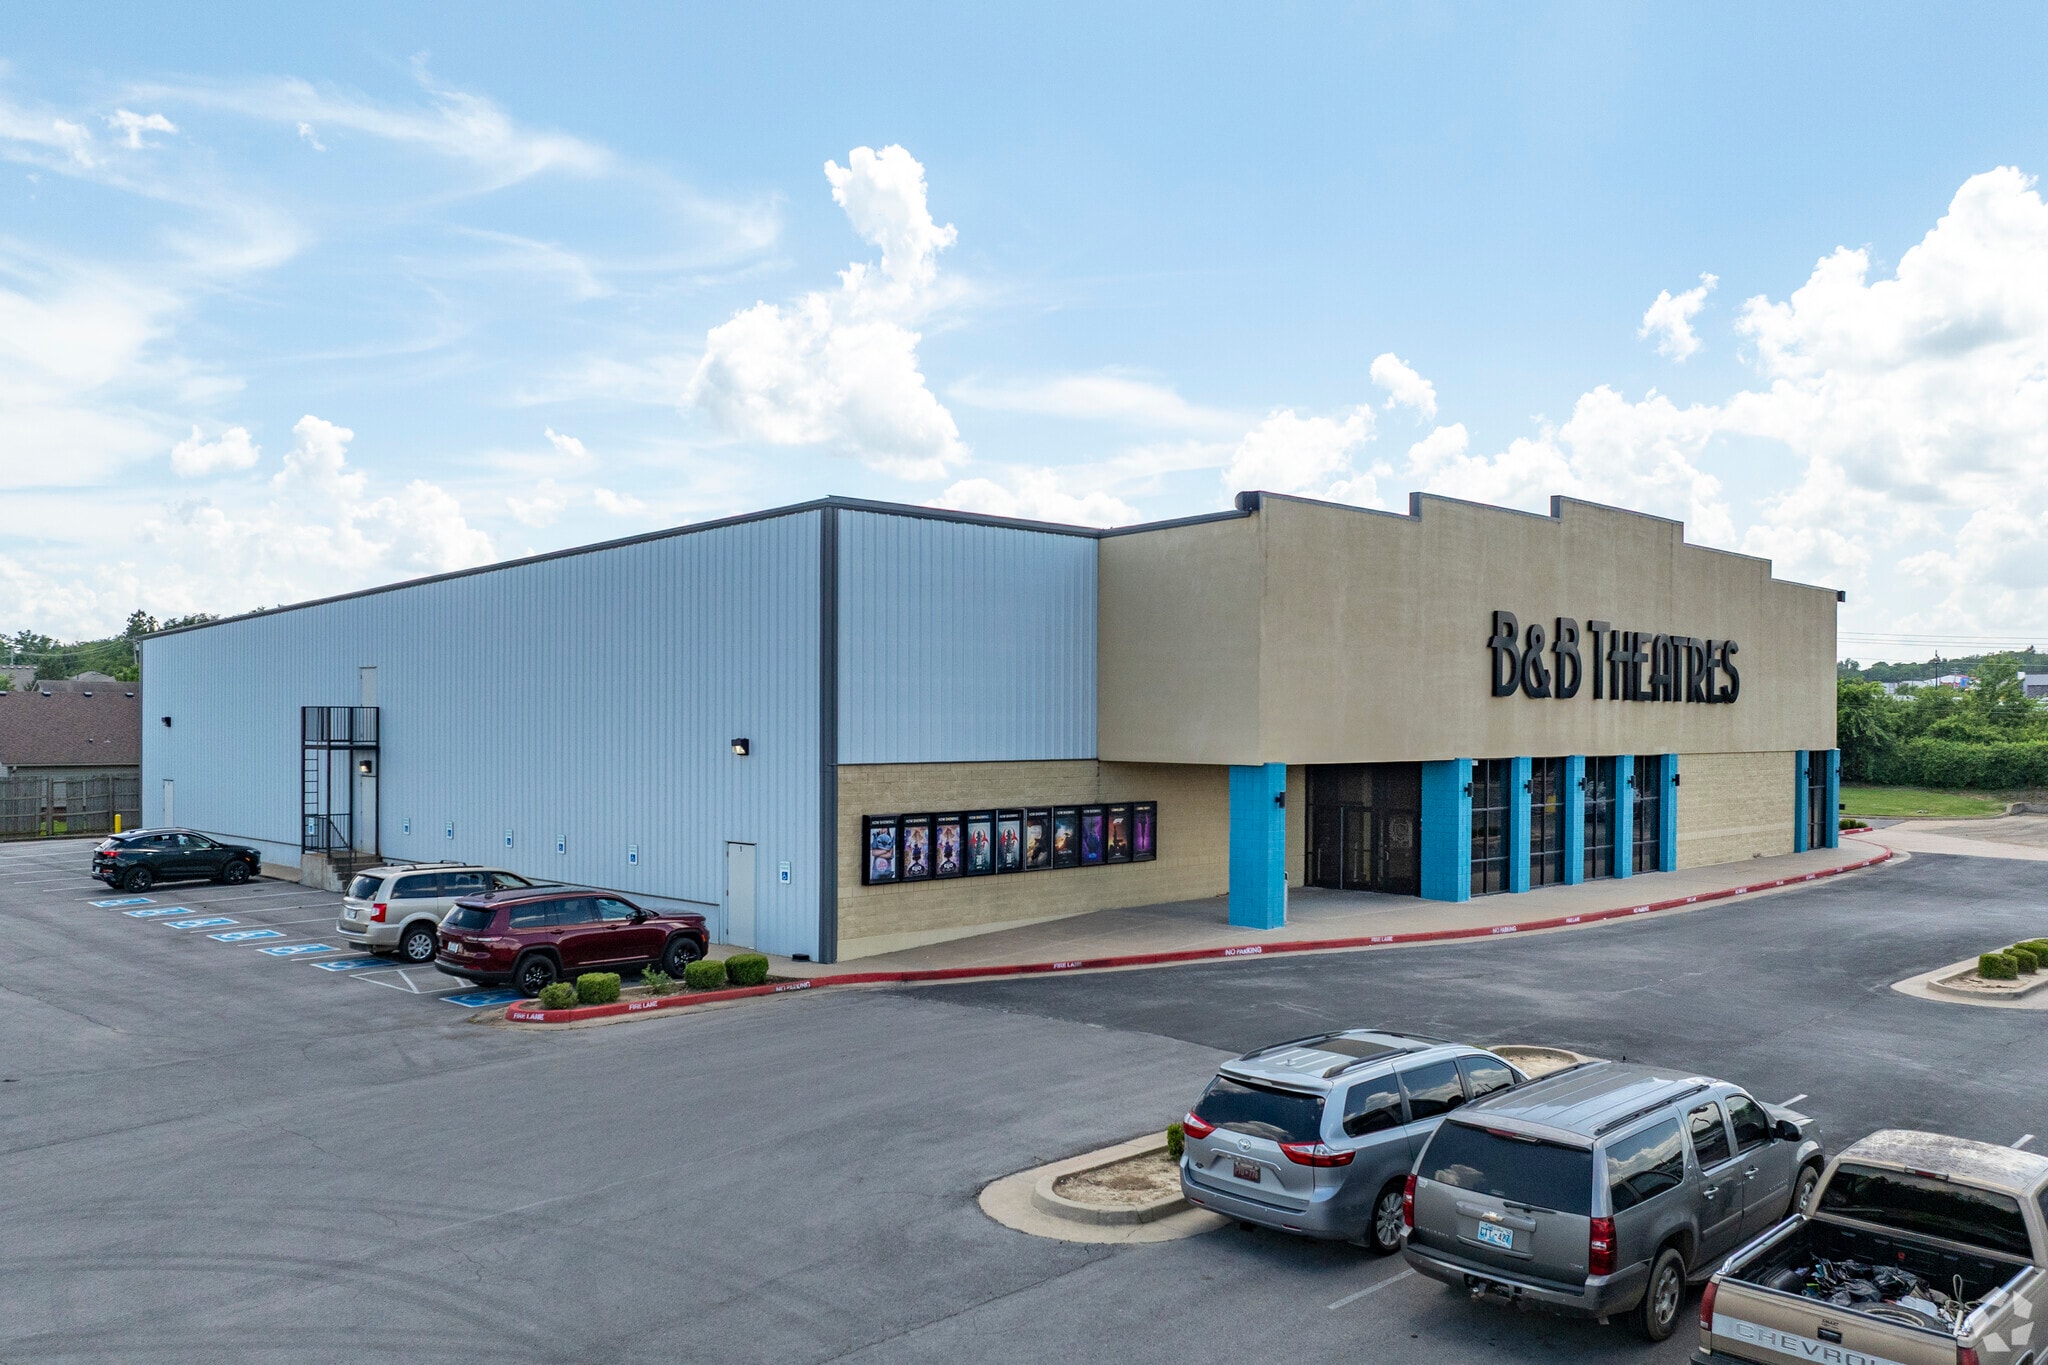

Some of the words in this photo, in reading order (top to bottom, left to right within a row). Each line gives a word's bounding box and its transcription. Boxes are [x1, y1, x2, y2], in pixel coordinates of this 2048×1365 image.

[1487, 610, 1582, 699] B&B
[1588, 620, 1740, 704] THEATRES
[1237, 946, 1262, 954] PARKING
